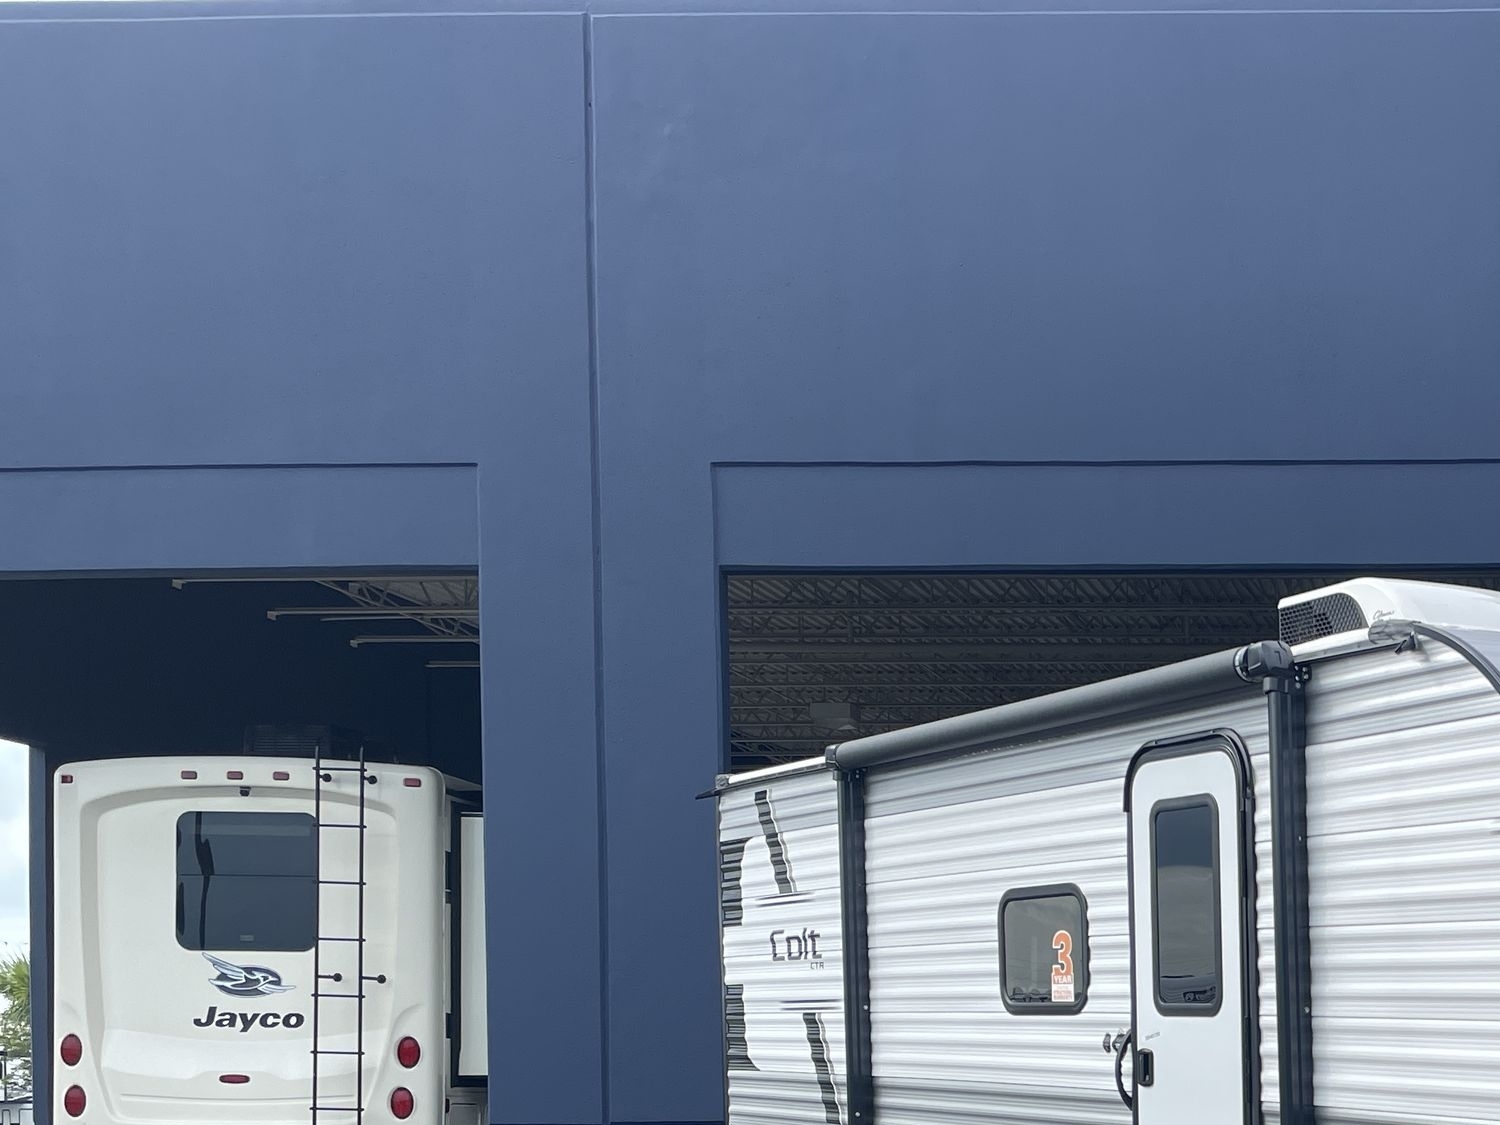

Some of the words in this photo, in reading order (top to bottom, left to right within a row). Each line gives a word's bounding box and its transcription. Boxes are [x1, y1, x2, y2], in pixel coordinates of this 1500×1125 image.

[770, 927, 823, 961] Colt
[1052, 930, 1073, 976] 3
[1053, 975, 1072, 984] YEAR
[193, 1006, 305, 1033] Jayco
